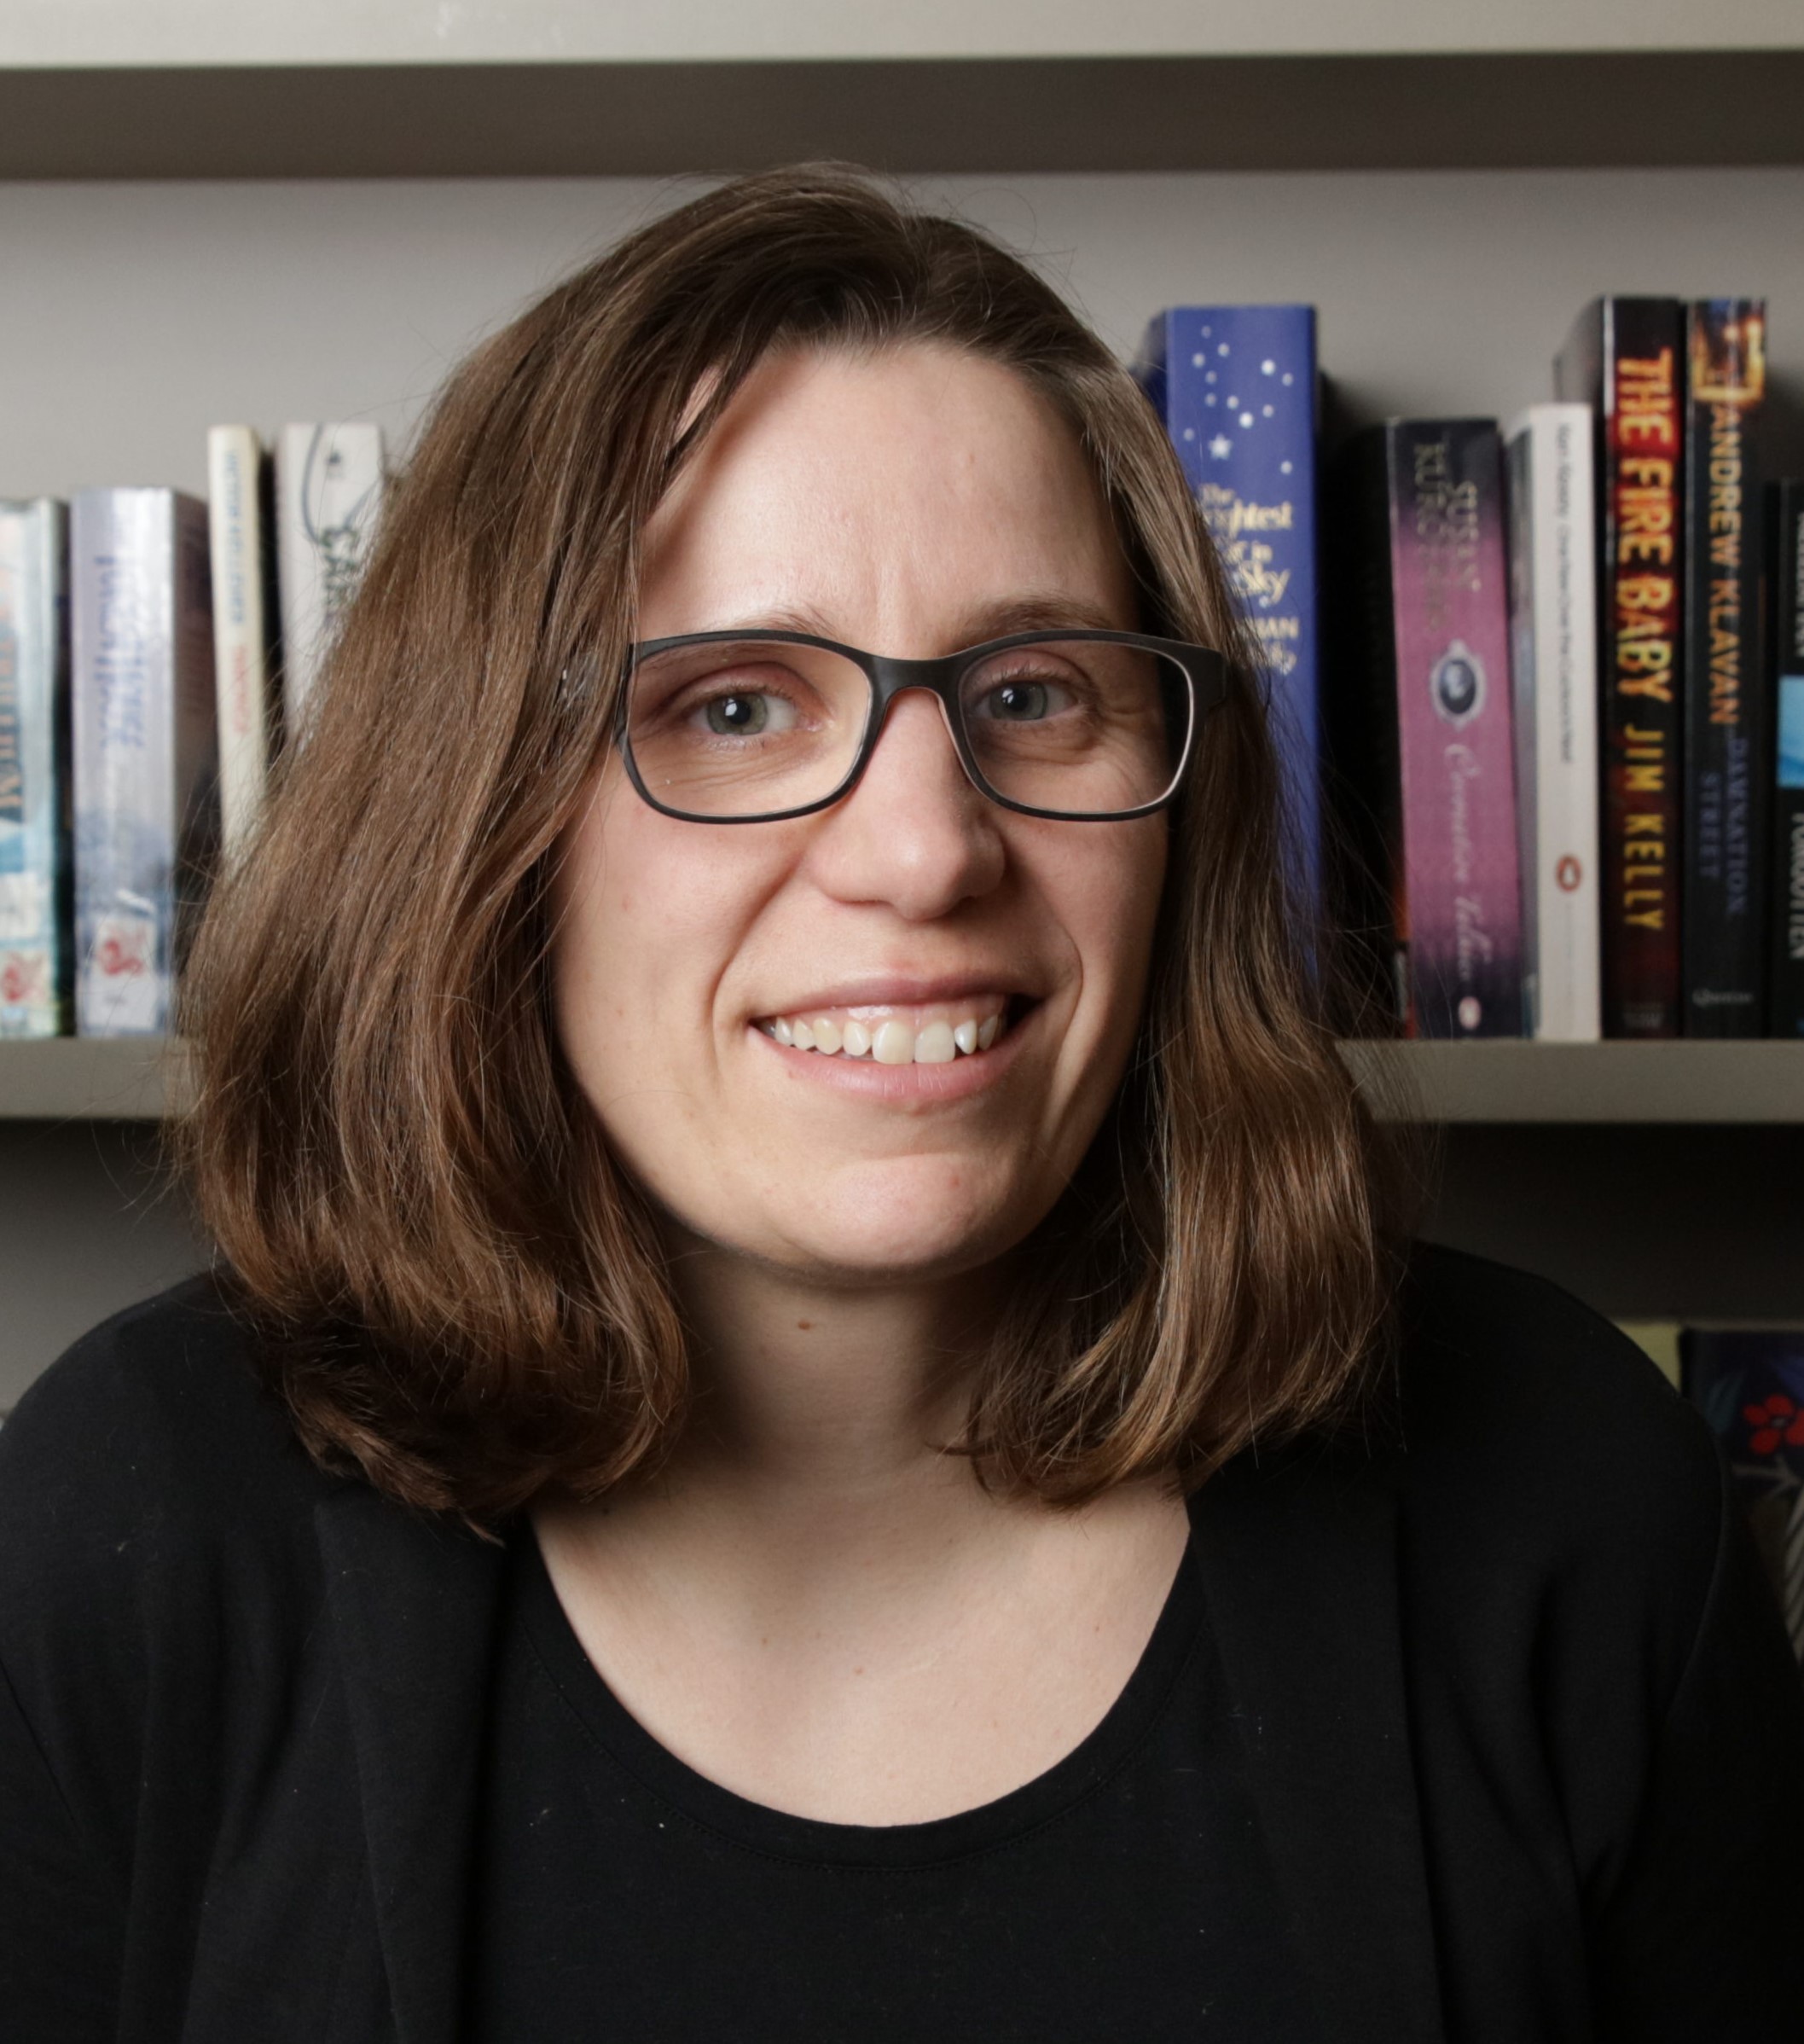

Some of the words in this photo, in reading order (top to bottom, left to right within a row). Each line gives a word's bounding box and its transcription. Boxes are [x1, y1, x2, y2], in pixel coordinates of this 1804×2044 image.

[1617, 347, 1675, 444] THE
[1617, 457, 1675, 565] FIRE
[1708, 405, 1742, 569] ANDREW
[1616, 576, 1675, 703] BABY
[1708, 578, 1742, 725] KLAVAN
[1624, 722, 1667, 792] JIM
[1623, 813, 1667, 932] KELLY
